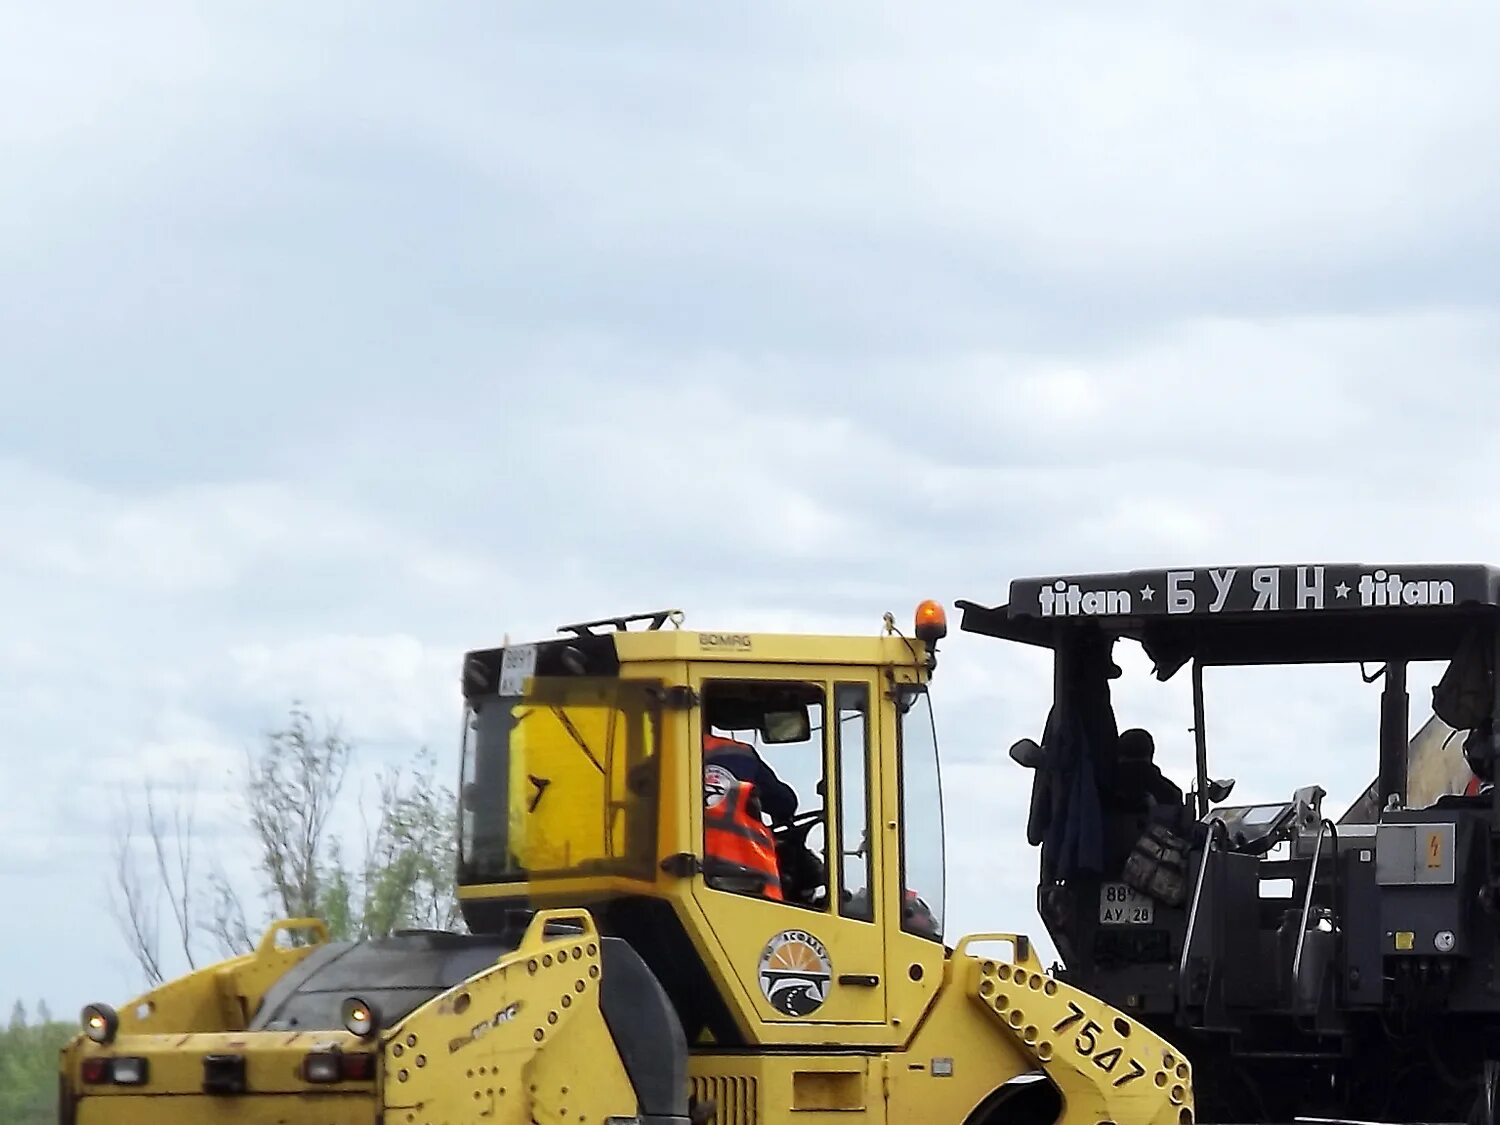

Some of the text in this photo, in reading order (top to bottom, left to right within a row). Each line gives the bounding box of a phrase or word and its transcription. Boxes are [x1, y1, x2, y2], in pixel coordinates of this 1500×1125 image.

[1038, 580, 1131, 616] titan
[1167, 566, 1325, 614] БУЯН
[1358, 569, 1454, 606] titan
[1052, 1001, 1146, 1087] 7547
